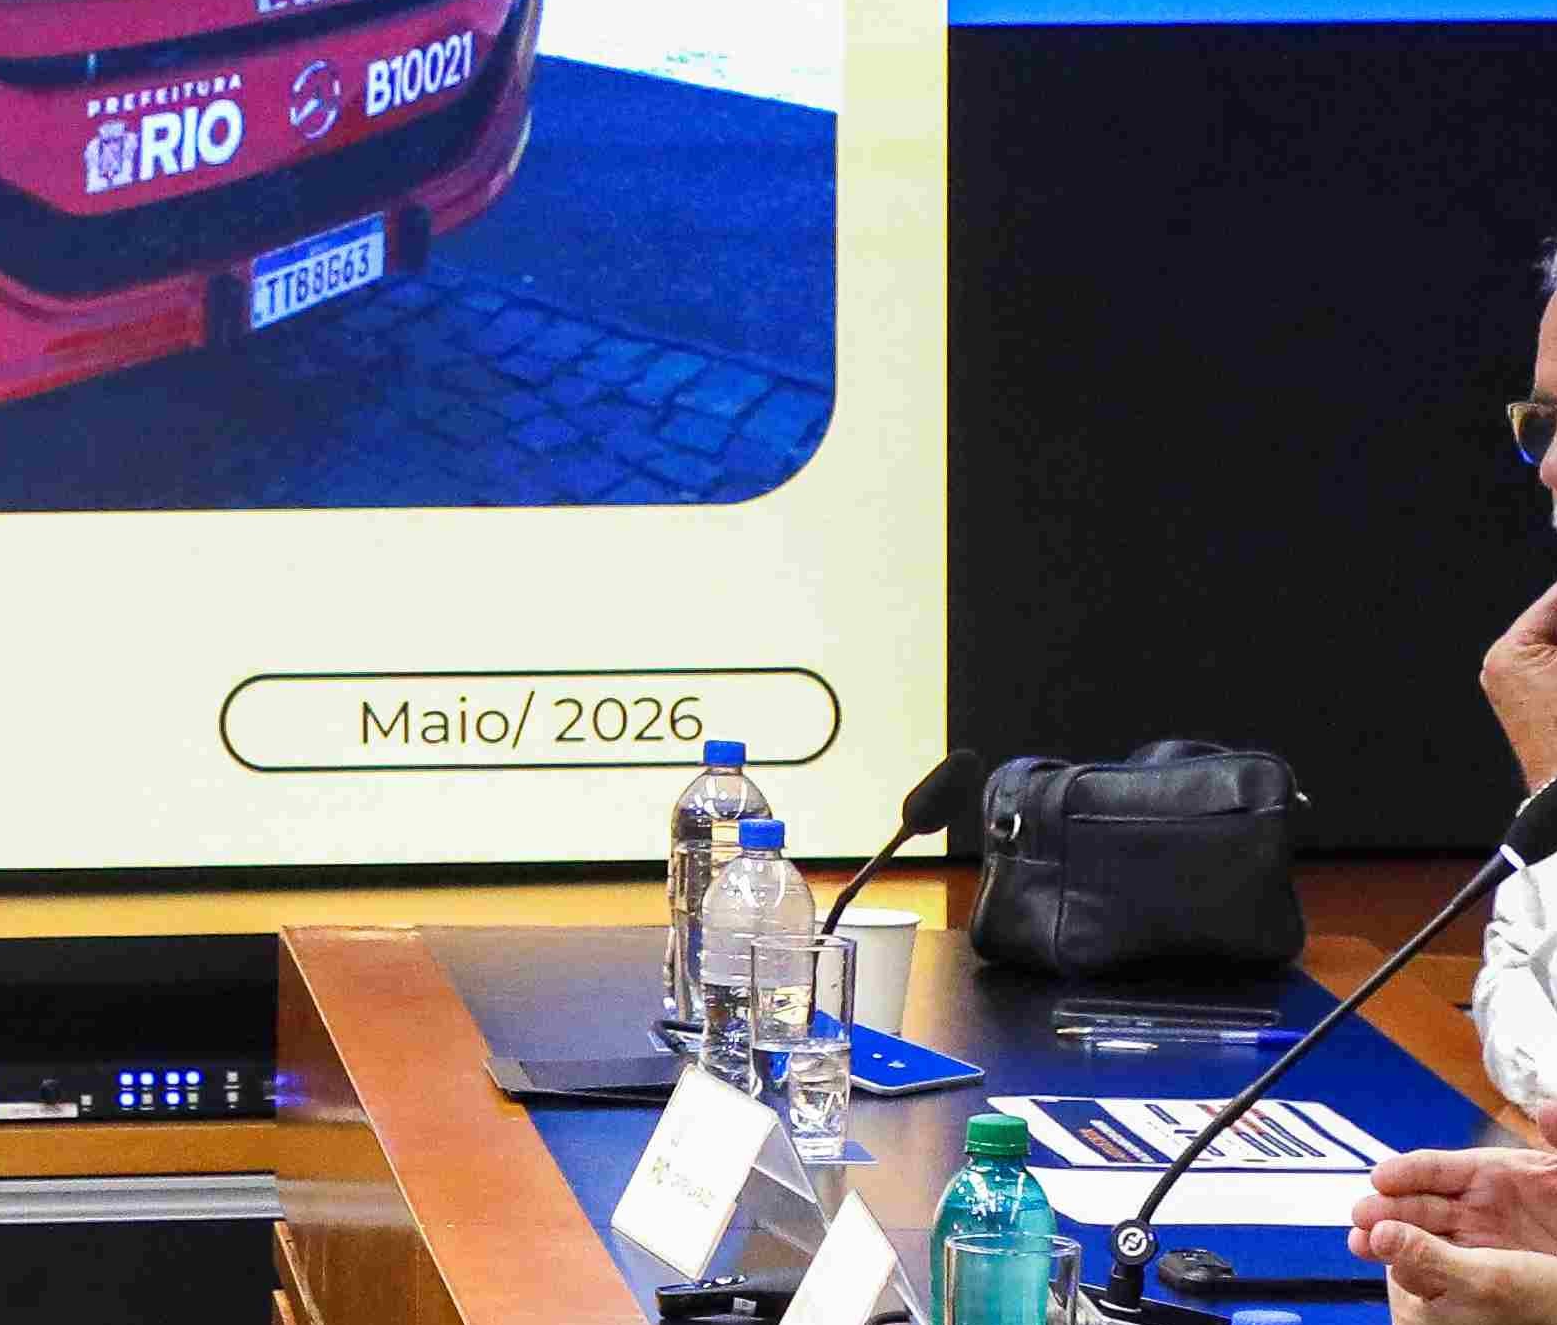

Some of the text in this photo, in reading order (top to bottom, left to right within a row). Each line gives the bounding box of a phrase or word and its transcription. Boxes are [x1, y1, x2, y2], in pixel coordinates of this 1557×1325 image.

[87, 74, 242, 118] PREFEITURA
[366, 31, 472, 116] B10021
[139, 99, 244, 181] RIO
[363, 691, 703, 748] Maio/ 2026
